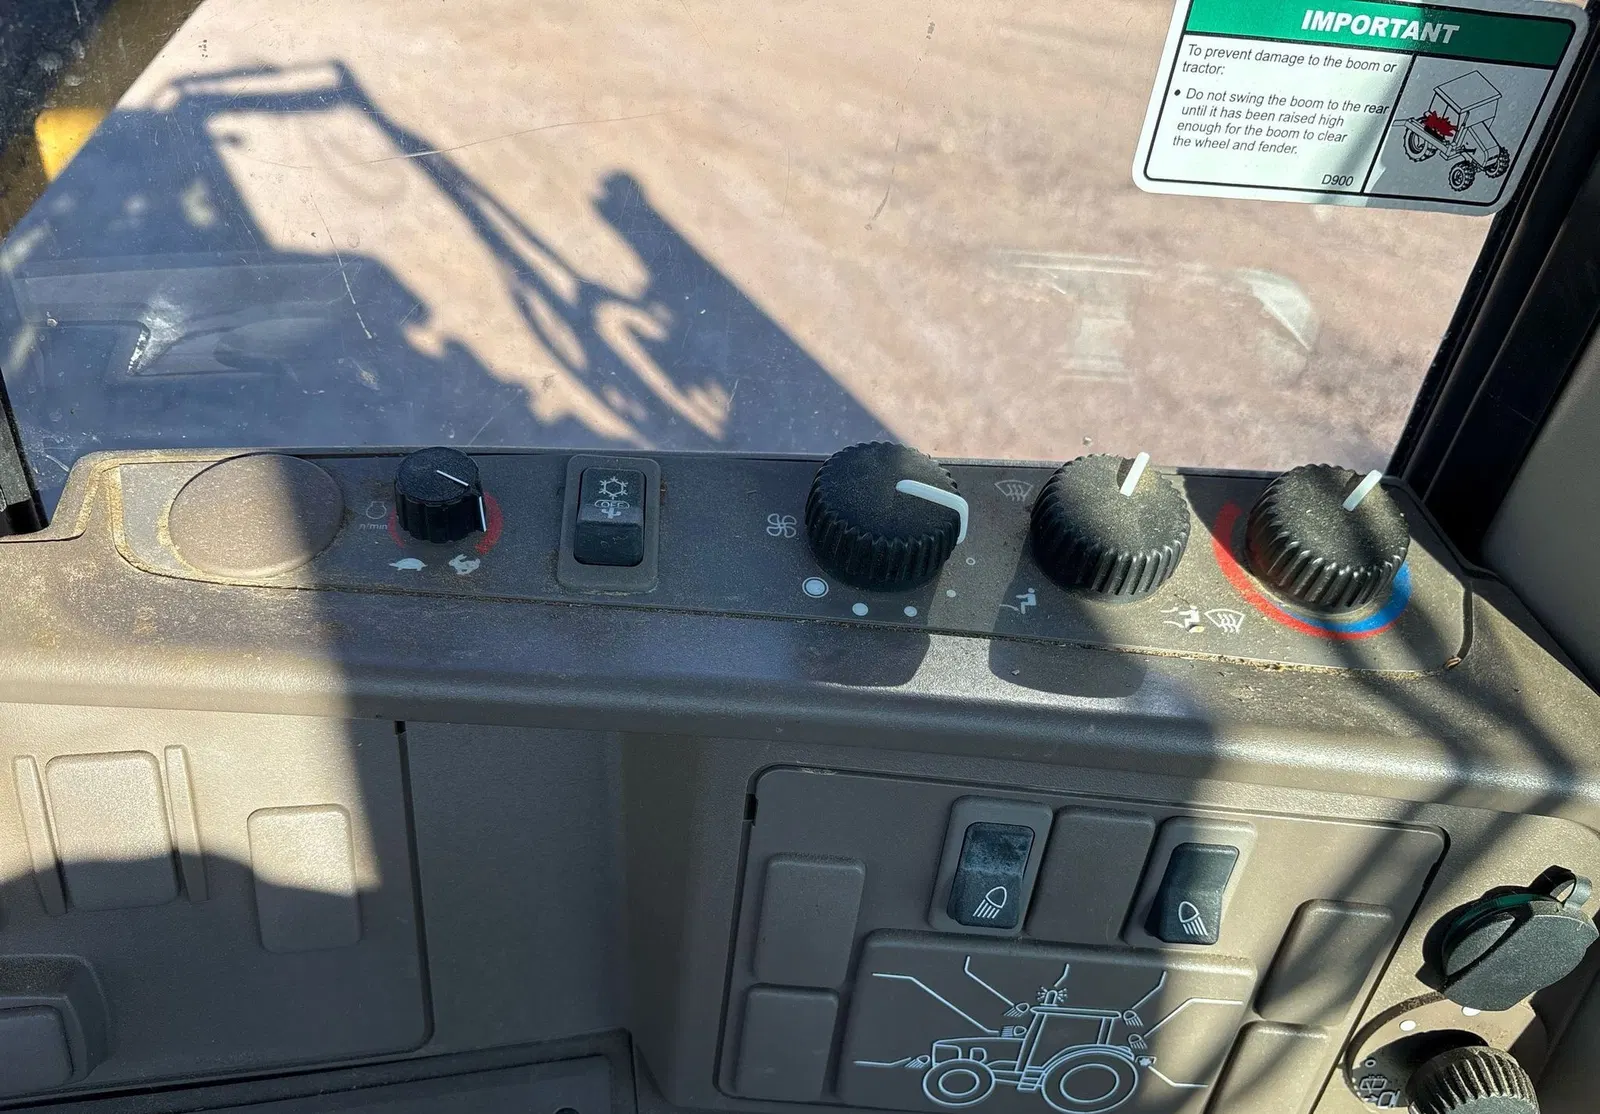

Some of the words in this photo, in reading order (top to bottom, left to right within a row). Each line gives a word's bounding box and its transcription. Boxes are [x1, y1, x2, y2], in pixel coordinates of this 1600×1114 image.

[1301, 9, 1460, 44] IMPORTANT
[1182, 61, 1225, 75] tractor:
[1189, 44, 1201, 56] To
[1204, 48, 1252, 60] prevent
[1254, 50, 1305, 67] damage
[1307, 54, 1320, 66] to
[1323, 55, 1343, 68] the
[1345, 57, 1380, 71] boom
[1383, 63, 1397, 73] or
[1186, 88, 1203, 100] Do
[1206, 91, 1227, 102] not
[1229, 92, 1264, 107] swing
[1267, 94, 1286, 106] the
[1289, 96, 1324, 109] boom
[1327, 99, 1339, 110] to
[1342, 100, 1361, 112] the
[1363, 104, 1389, 115] rear
[1181, 105, 1207, 117] until
[1209, 106, 1218, 117] it
[1219, 106, 1242, 119] has
[1245, 108, 1275, 122] been
[1278, 112, 1317, 125] raised
[1318, 114, 1344, 128] high
[1177, 122, 1222, 135] enough
[1225, 122, 1242, 134] for
[1244, 124, 1263, 136] the
[1266, 126, 1300, 139] boom
[1303, 129, 1314, 140] to
[1317, 131, 1348, 142] clear
[1172, 135, 1191, 147] the
[1195, 137, 1231, 149] wheel
[1232, 140, 1256, 151] and
[1258, 141, 1298, 154] fender.
[1321, 174, 1354, 186] D900
